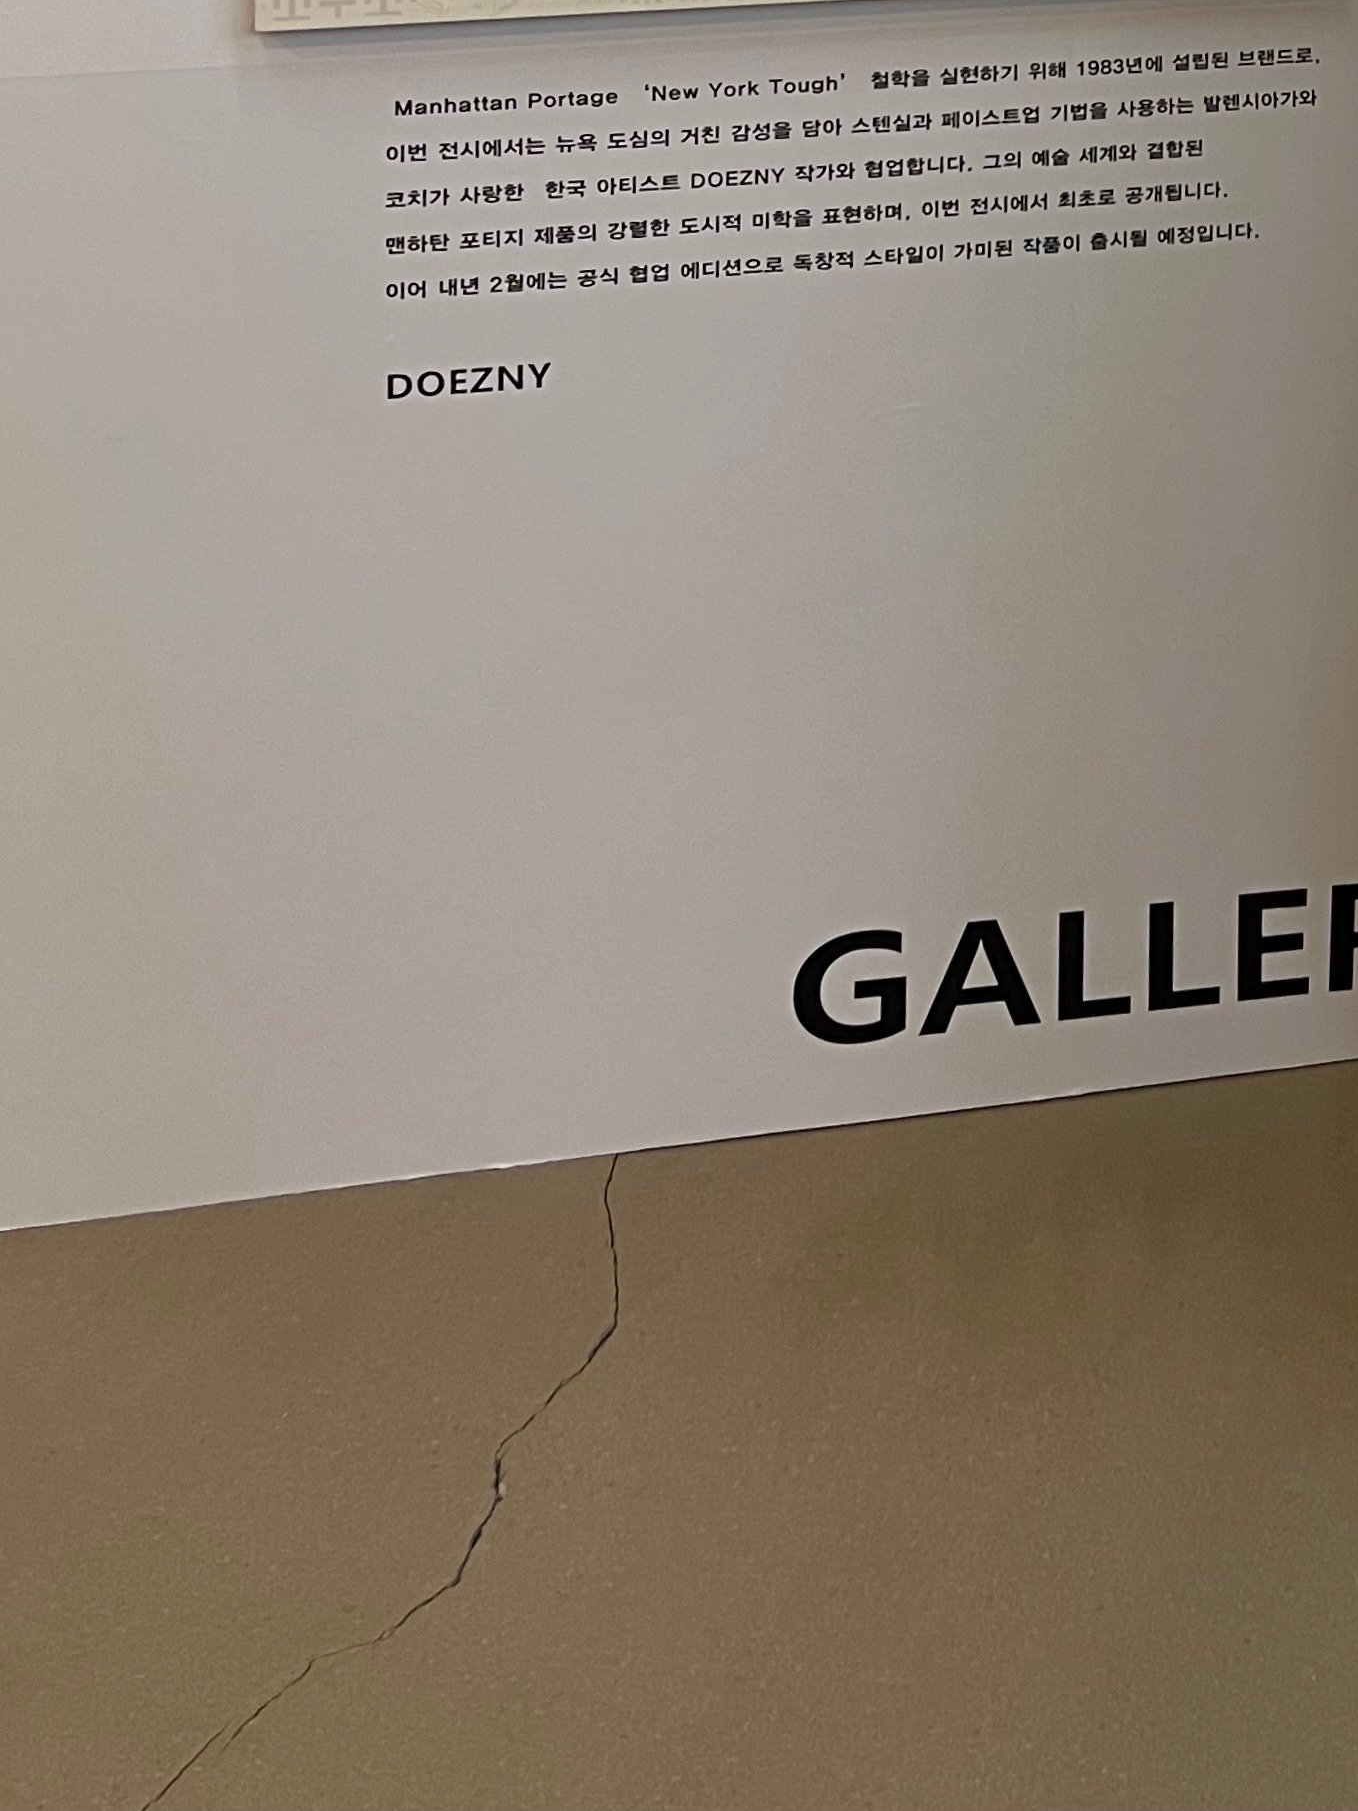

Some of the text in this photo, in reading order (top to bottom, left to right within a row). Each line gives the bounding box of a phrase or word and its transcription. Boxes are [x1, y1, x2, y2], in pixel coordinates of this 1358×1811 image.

[394, 96, 518, 117] Manhattan
[527, 91, 619, 109] Portage
[708, 80, 760, 99] York
[870, 68, 931, 90] 철학을
[939, 63, 1019, 86] 실현하기
[1028, 60, 1067, 81] 위해
[1076, 55, 1163, 77] 1983년에
[1172, 51, 1229, 72] 설립된
[386, 88, 1318, 163] 이번 전시에서는 뉴욕 도심의 거친 감성을 담아 스텐실과 페이스트업 기법을 사용하는 발렌시아가와
[384, 138, 1203, 209] 코치가 사랑한 한국 아티스트 DOEZNY 작가와 협업합니다. 그의 예술 세계와 결합된
[385, 232, 451, 255] 맨하탄
[458, 228, 524, 250] 포티지
[533, 223, 597, 245] 제품의
[607, 218, 671, 241] 강렬한
[678, 213, 742, 235] 도시적
[752, 208, 814, 230] 미학을
[921, 198, 960, 219] 이번
[970, 192, 1048, 216] 전시에서
[1057, 188, 1117, 209] 최초로
[1124, 180, 1228, 205] 공개됩니다.
[385, 221, 1260, 300] 이어 내년 2월에는 공식 협업 에디션으로 독창적 스타일이 가미된 작품이 출시될 예정입니다.
[386, 361, 552, 400] DOEZNY
